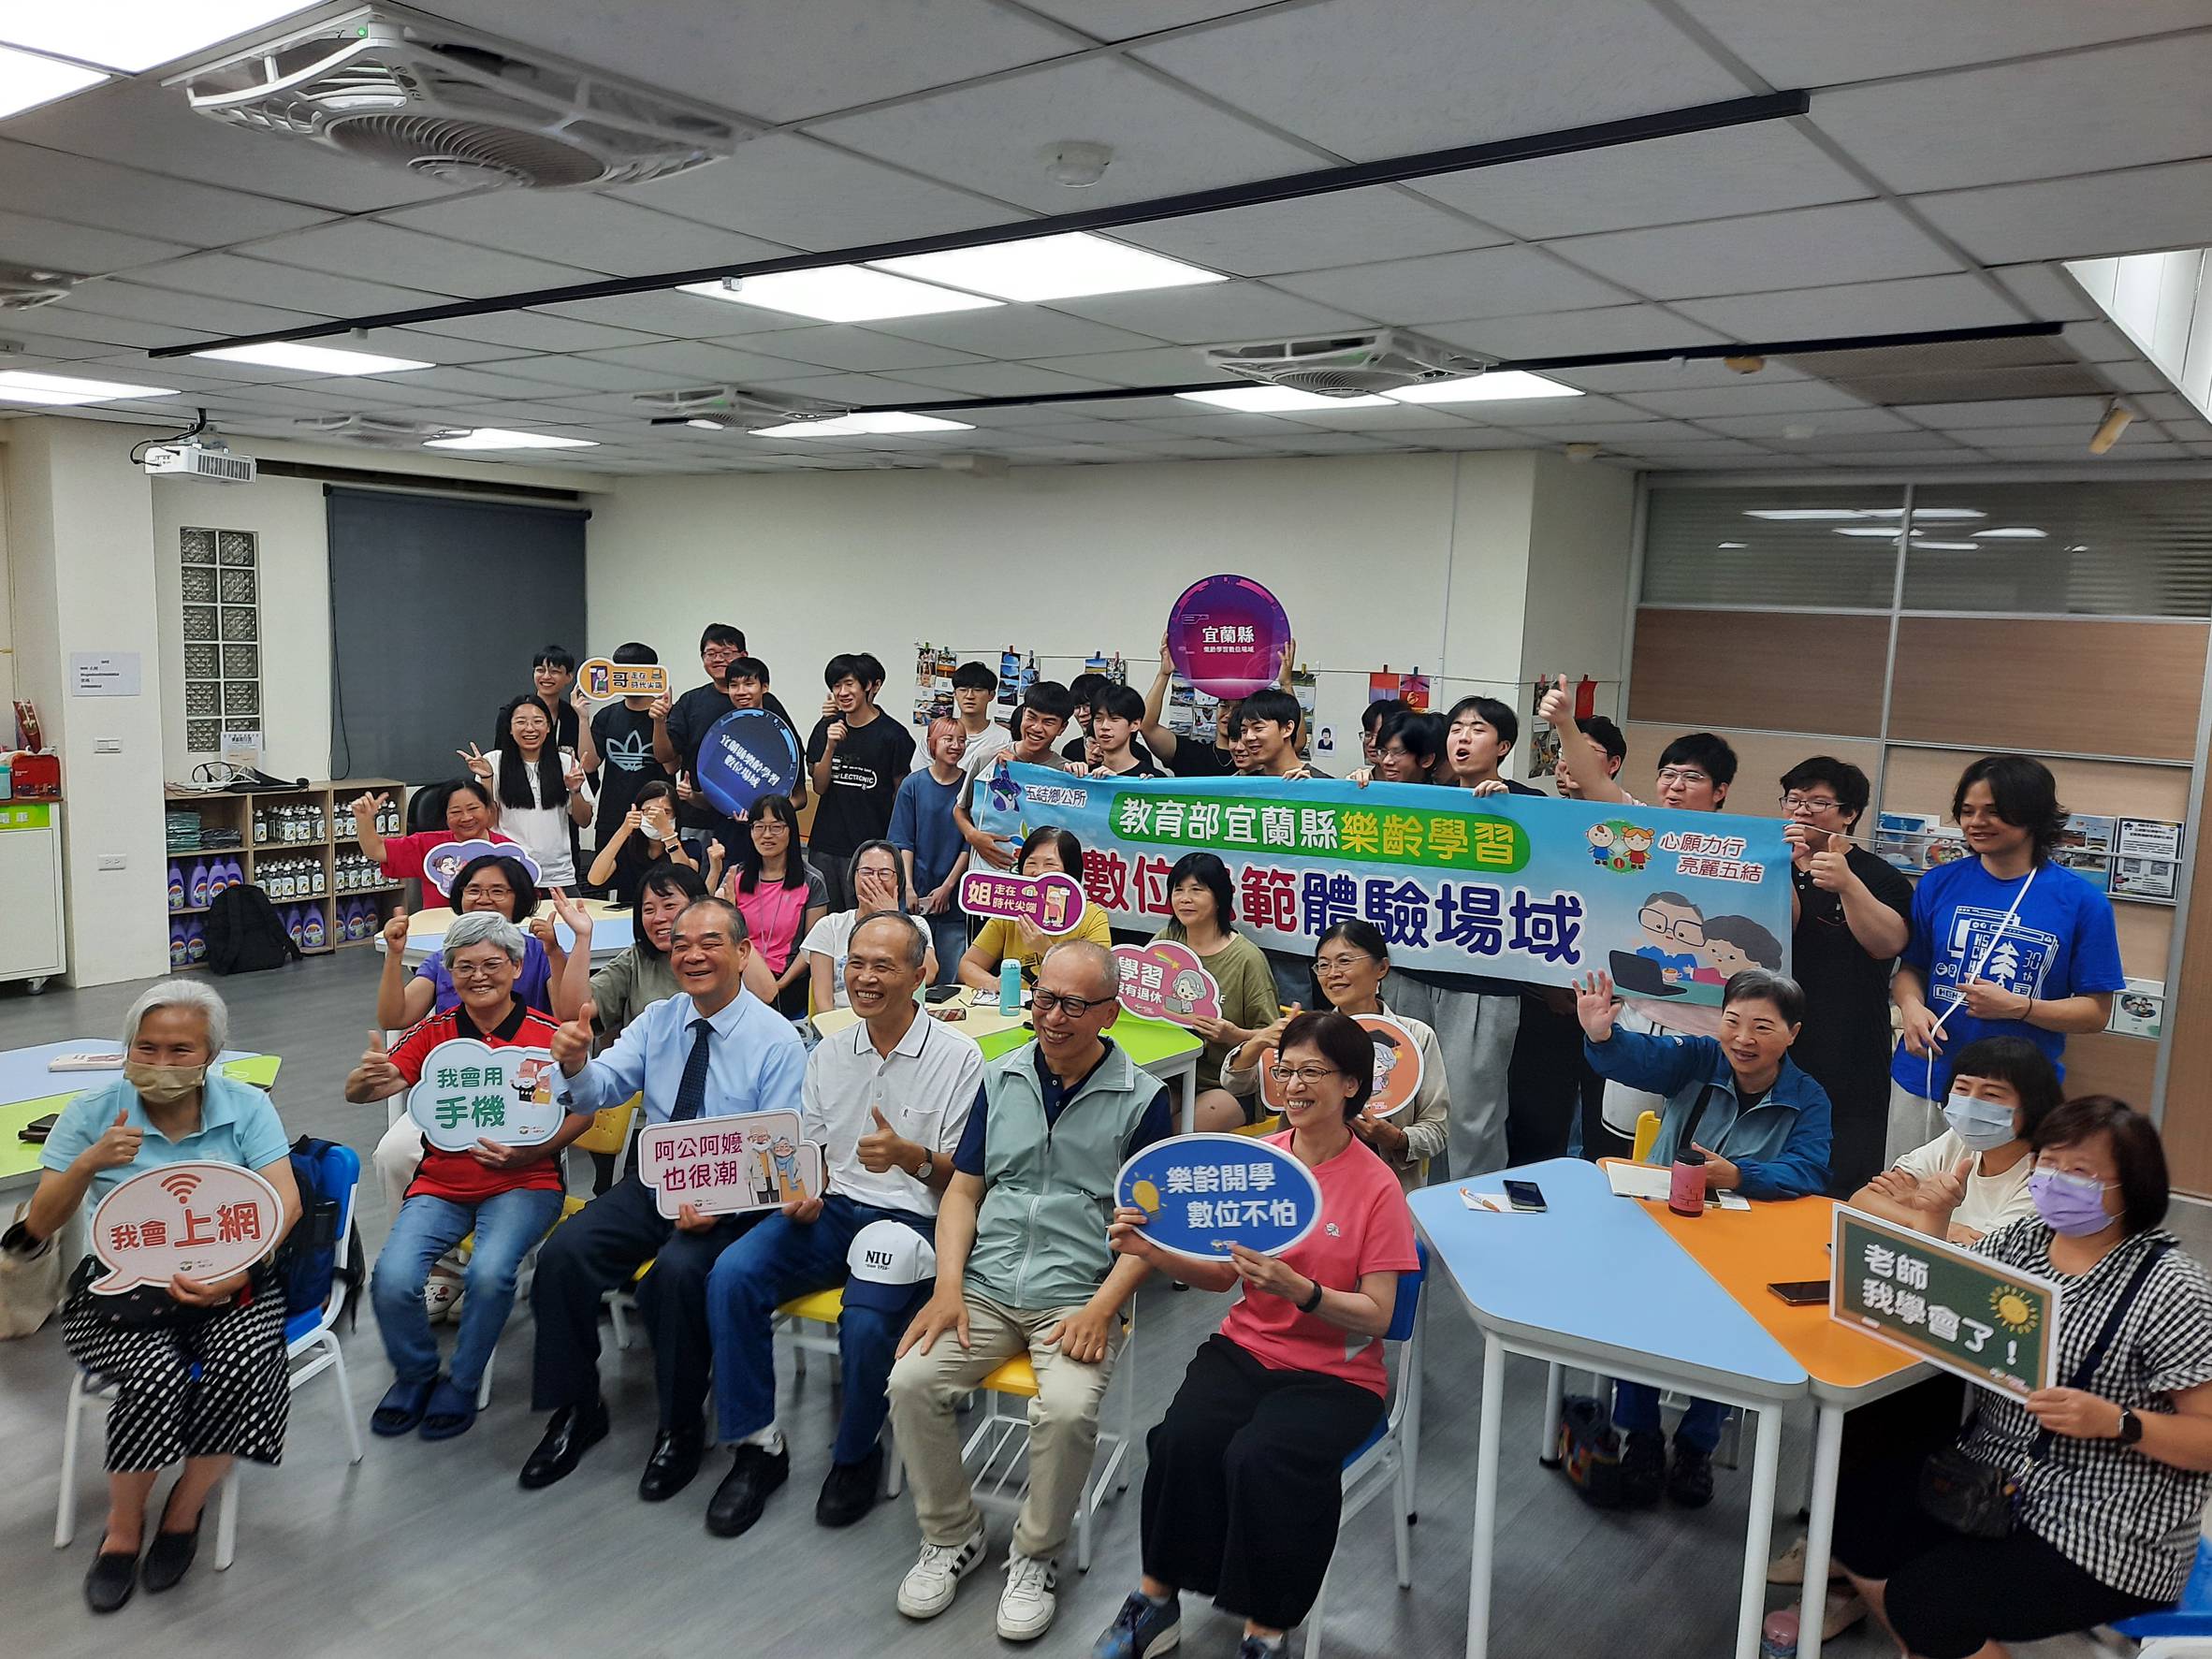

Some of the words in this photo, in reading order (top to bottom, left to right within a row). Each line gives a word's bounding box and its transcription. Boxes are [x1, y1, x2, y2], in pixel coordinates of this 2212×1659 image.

[1202, 626, 1255, 644] 宜蘭縣
[613, 672, 628, 688] 哥
[1026, 785, 1086, 807] 五結鄉公所
[1118, 797, 1514, 865] 教育部宜蘭縣樂齡學習
[1660, 833, 1745, 857] 心願力行
[1678, 857, 1763, 882] 亮麗五結
[968, 880, 992, 906] 姐
[994, 883, 1016, 896] 走在
[992, 897, 1037, 913] 時代尖端
[1083, 849, 1583, 965] 數位範體驗場域
[2022, 950, 2042, 969] 30
[1118, 956, 1163, 989] 學習
[2023, 971, 2033, 982] th
[437, 1066, 503, 1088] 我會用
[435, 1095, 505, 1128] 手機
[655, 1131, 743, 1162] 阿公阿嬤
[662, 1161, 737, 1191] 也很潮
[1167, 1162, 1276, 1194] 樂齡開學
[110, 1202, 261, 1251] 我會上網
[1186, 1199, 1297, 1229] 數位不怕
[866, 1250, 893, 1265] NIU
[1864, 1244, 1929, 1289] 老師
